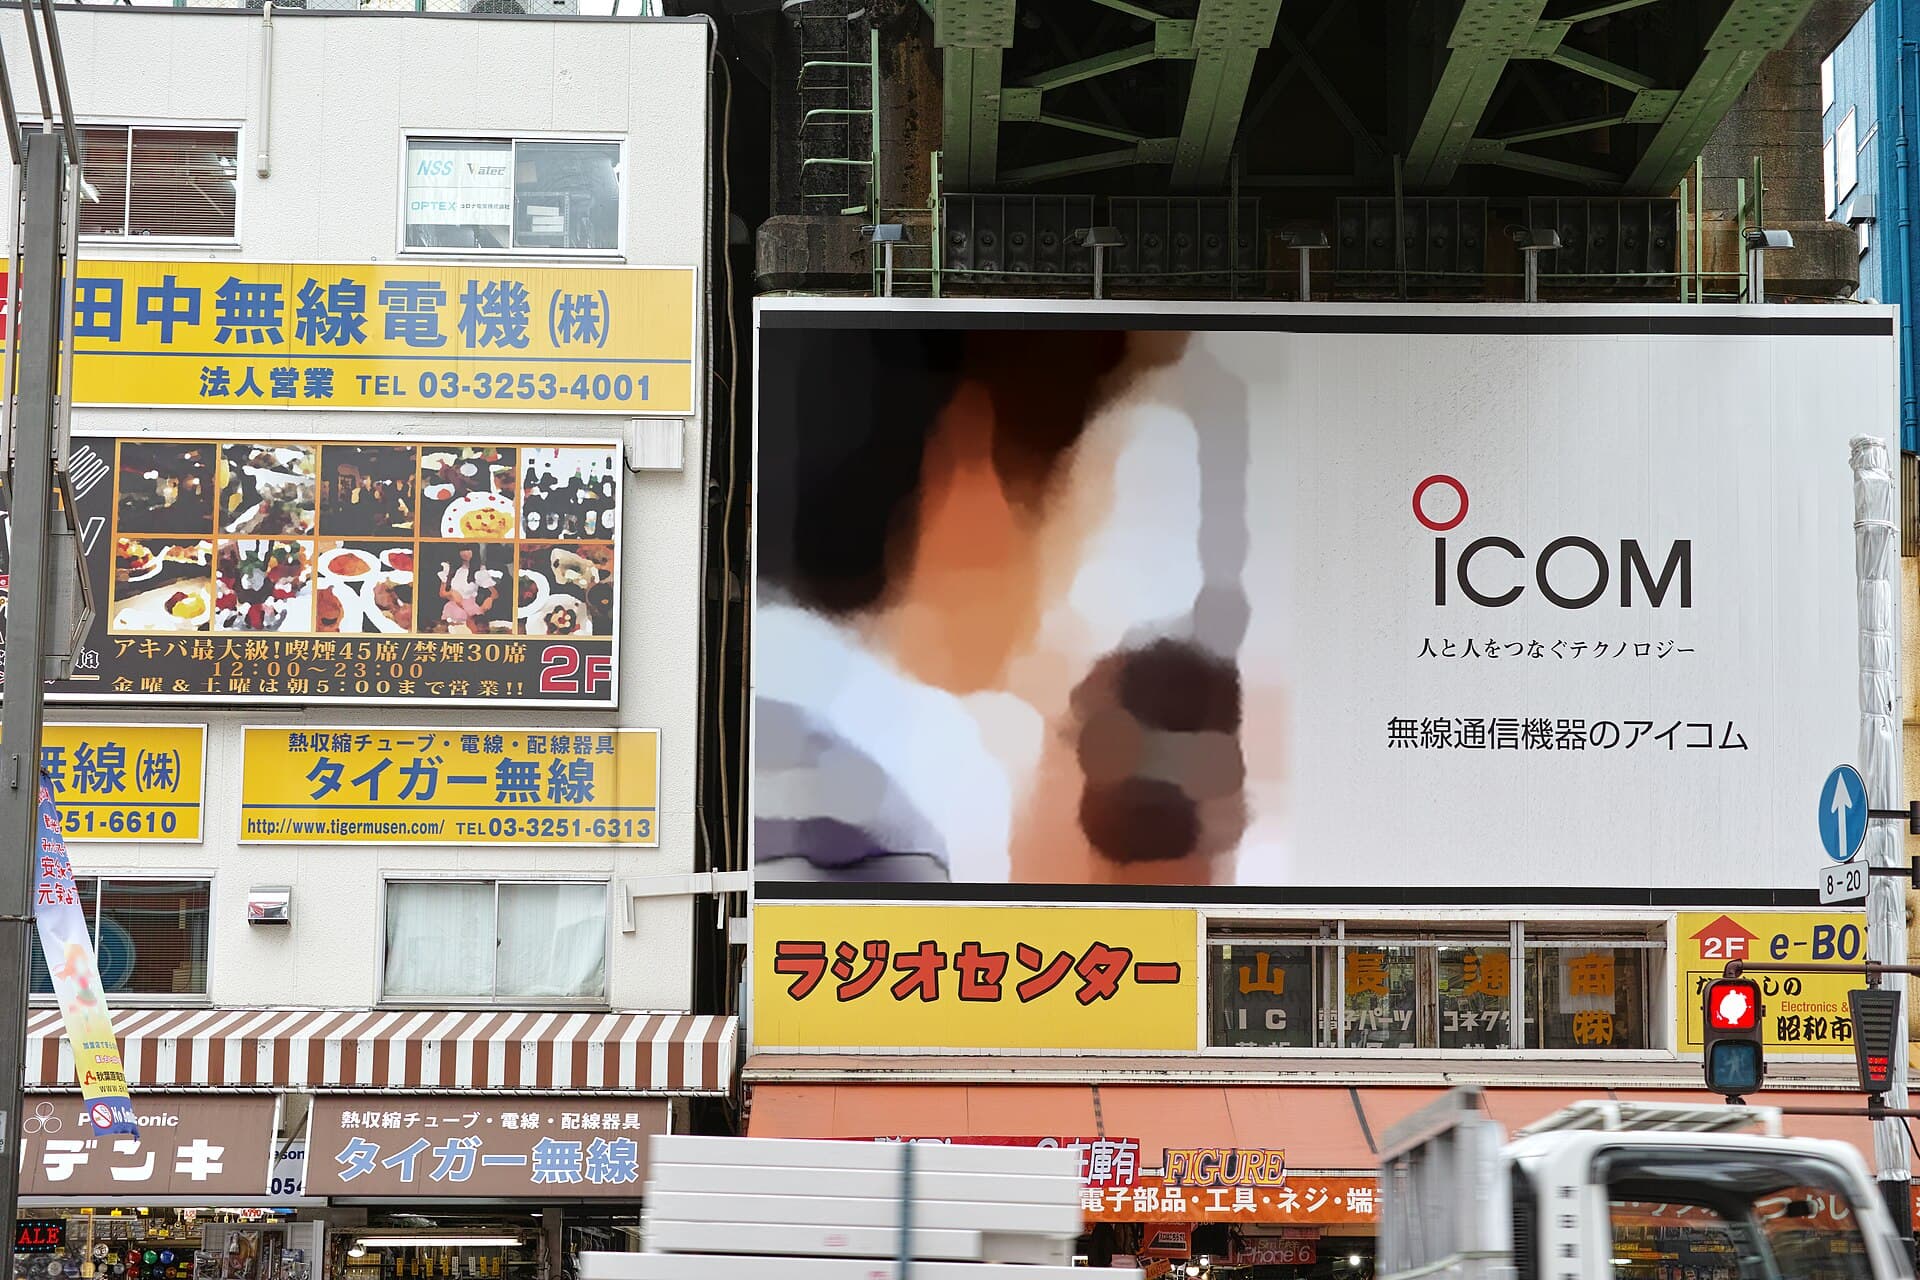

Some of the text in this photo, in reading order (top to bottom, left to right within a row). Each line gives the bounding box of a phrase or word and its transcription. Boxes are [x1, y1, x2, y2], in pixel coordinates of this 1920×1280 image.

[417, 160, 453, 176] NSS
[411, 201, 456, 211] OPTEX
[200, 366, 651, 402] 法人営業 TEL 03-3253-4001
[1417, 637, 1696, 660] 人と人をつなぐテクノロジー
[539, 644, 611, 693] 2F
[287, 732, 615, 756] 熱収縮チューブ・電線・配線器具
[1386, 716, 1749, 751] 無線通信機器のアイコム
[305, 755, 596, 805] タイガー無線
[247, 817, 652, 839] http://www.tigermusen.com/ TEL 03-3251-6313
[1703, 936, 1745, 958] 2F
[773, 939, 1182, 1006] ラジオセンター
[1781, 1000, 1838, 1014] Electronics
[340, 1110, 641, 1131] 熱収縮チューブ・電線・配線器具
[334, 1135, 640, 1185] タイガー無線
[1163, 1149, 1286, 1186] FIGURE
[1298, 1245, 1311, 1262] 6
